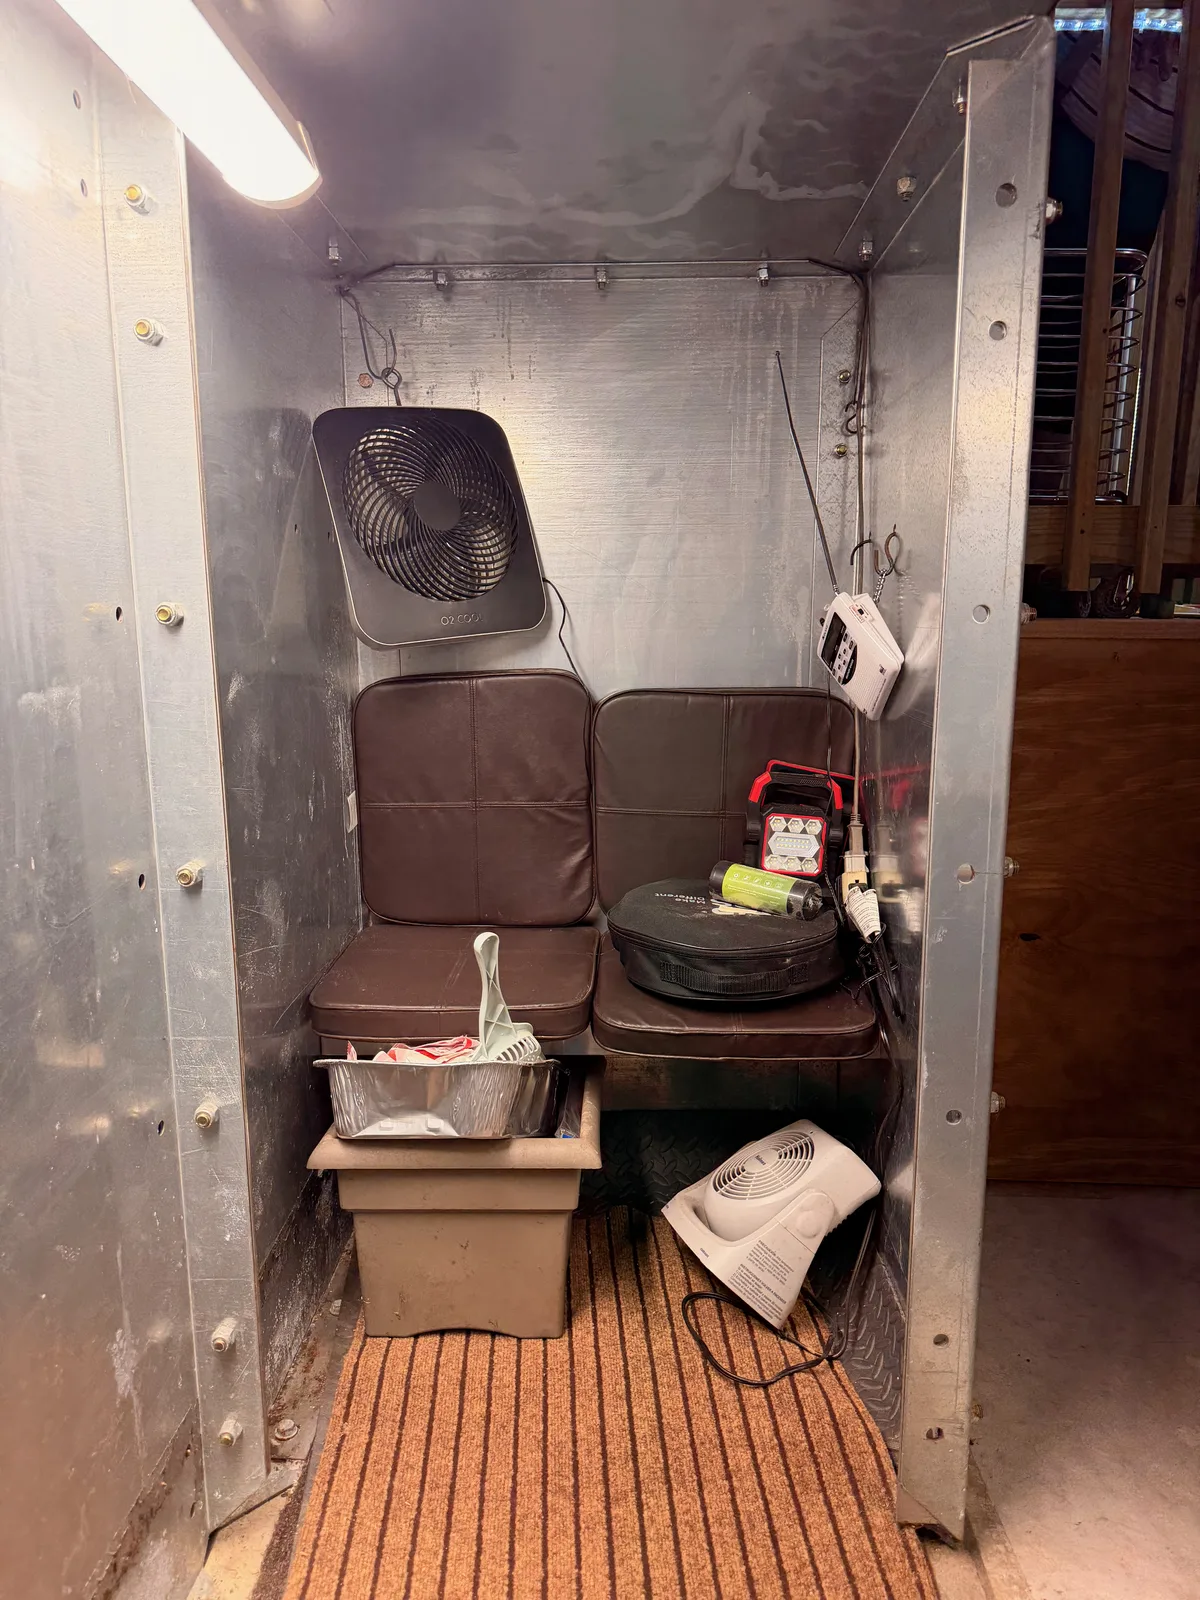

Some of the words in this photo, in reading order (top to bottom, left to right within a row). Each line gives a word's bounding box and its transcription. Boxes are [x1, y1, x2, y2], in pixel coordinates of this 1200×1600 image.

[440, 615, 455, 626] O2
[654, 892, 706, 901] Different
[674, 897, 706, 905] Make
